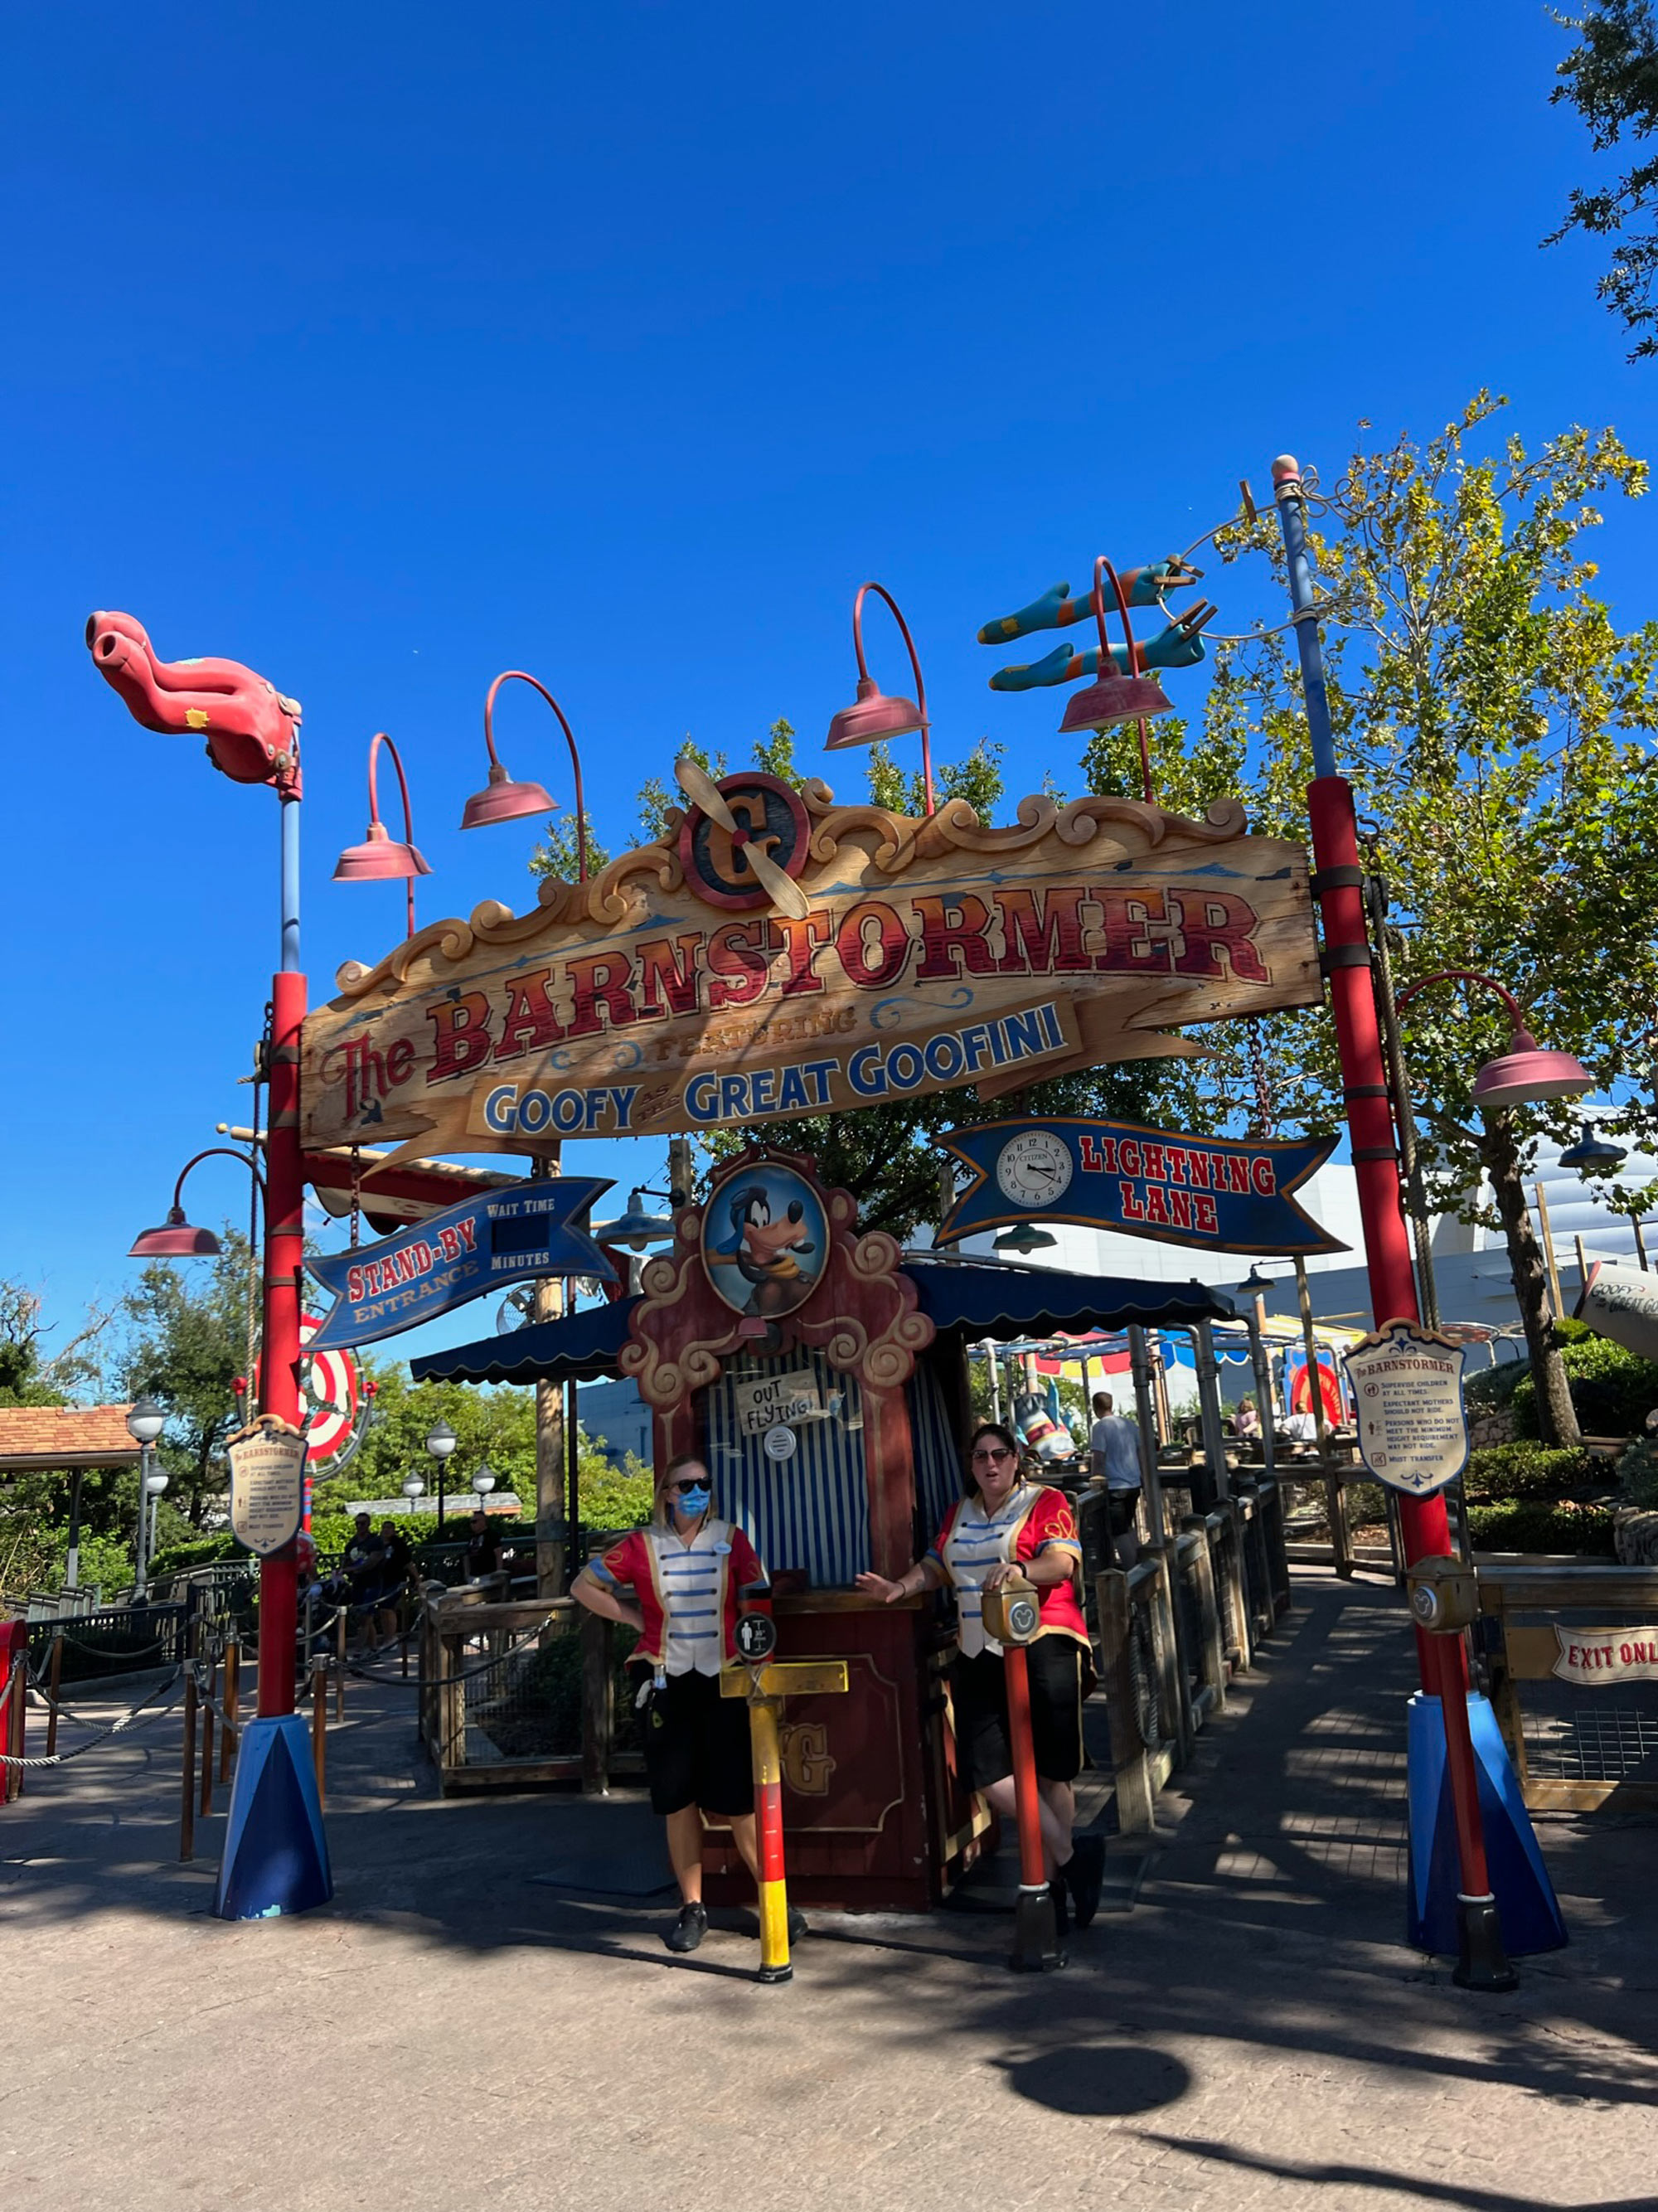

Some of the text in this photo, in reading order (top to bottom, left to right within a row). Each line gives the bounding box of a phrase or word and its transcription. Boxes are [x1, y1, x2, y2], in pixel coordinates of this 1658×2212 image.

[704, 792, 782, 886] G
[320, 886, 1273, 1123] The BARNSTORMER
[684, 1002, 1068, 1123] GREAT GOOFINI
[483, 1084, 645, 1134] GOOFY
[1016, 1143, 1023, 1152] 11
[1028, 1138, 1037, 1147] 12
[1006, 1153, 1016, 1162] 10
[1020, 1153, 1048, 1162] CITIZEN
[1054, 1147, 1060, 1157] 2
[1005, 1167, 1011, 1176] 9
[1059, 1162, 1065, 1170] 3
[1079, 1135, 1276, 1197] LIGHTNING
[1011, 1181, 1017, 1189] 8
[1047, 1186, 1054, 1196] 5
[1020, 1190, 1026, 1198] 7
[1034, 1191, 1040, 1200] 6
[487, 1198, 555, 1218] WAIT TIME
[1118, 1181, 1219, 1235] LANE
[347, 1216, 478, 1303] STAND-BY
[490, 1251, 550, 1270] MINUTES
[353, 1259, 479, 1324] ENTRANCE
[1591, 1283, 1633, 1297] GOOFY
[1367, 1359, 1456, 1375] BARNSTORMER
[753, 1380, 783, 1404] OUT
[1568, 1644, 1614, 1670] EXIT
